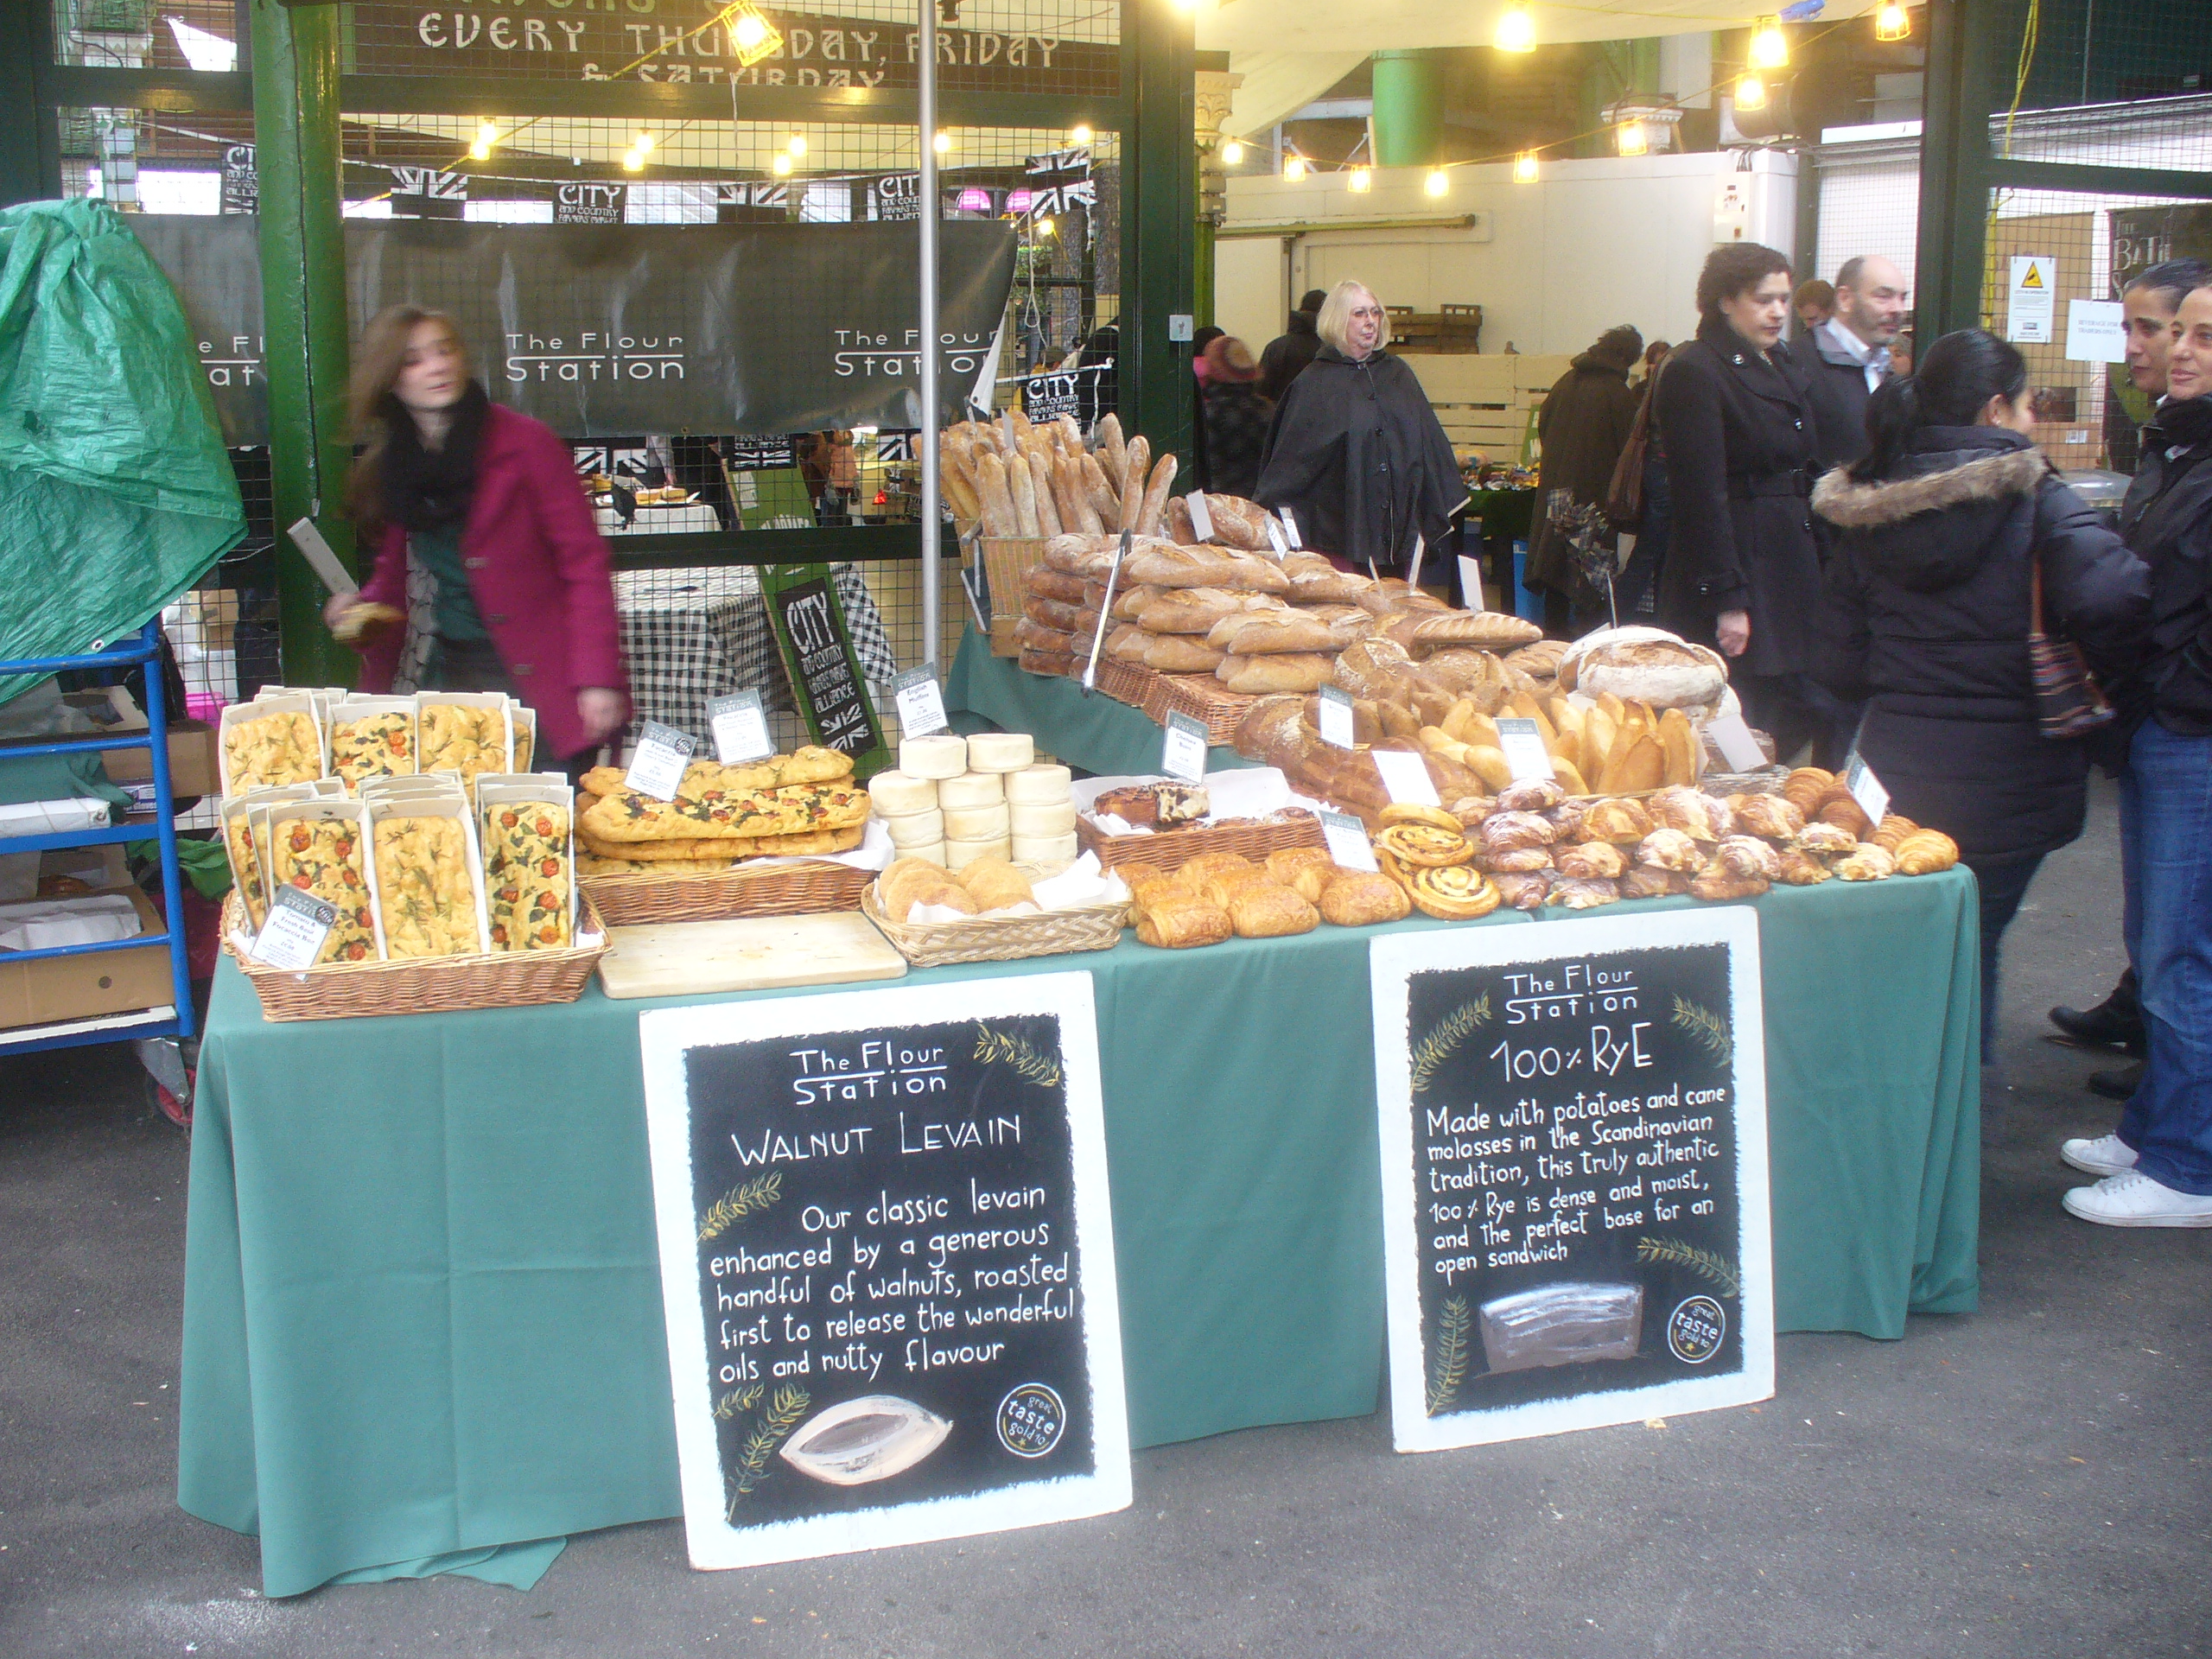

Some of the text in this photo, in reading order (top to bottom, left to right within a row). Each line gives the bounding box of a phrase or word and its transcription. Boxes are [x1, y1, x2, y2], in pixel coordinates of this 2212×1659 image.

[419, 12, 1060, 67] EVERY THUDAY, FRIDAY
[558, 184, 621, 208] CITY
[879, 175, 920, 198] CIT
[505, 333, 683, 350] The Flour
[835, 329, 998, 346] The Four
[505, 355, 684, 382] Station
[835, 352, 987, 377] Stato
[1027, 373, 1079, 401] CITY
[786, 591, 835, 655] CITY
[1503, 963, 1634, 995] The Flour
[1505, 991, 1638, 1025] Station
[789, 1041, 944, 1074] The Flour
[793, 1068, 947, 1105] Station
[1426, 1082, 1726, 1138] Made with potatoes and cane
[731, 1111, 1020, 1166] WALNUT LEVAIN
[1427, 1114, 1713, 1161] molasses in the Scandinavian
[1428, 1136, 1719, 1192] tradition, this truly authentic
[802, 1177, 1046, 1231] Our classic levain
[1485, 1191, 1516, 1224] Rye
[1526, 1196, 1541, 1212] is
[1548, 1186, 1597, 1209] dense
[1609, 1175, 1643, 1201] and
[1651, 1168, 1709, 1194] moist,
[1433, 1224, 1469, 1249] and
[1526, 1209, 1589, 1248] perfect
[1604, 1206, 1643, 1230] base
[1654, 1198, 1681, 1222] for
[1691, 1199, 1714, 1215] an
[710, 1223, 1050, 1276] enhanced by a generous
[1435, 1240, 1567, 1287] open sandwich
[717, 1251, 1068, 1312] handful of walnuts, roasted
[721, 1287, 1074, 1350] first to release the wonderful
[1676, 1313, 1718, 1339] taste
[720, 1337, 1005, 1382] oils and nutty flavour
[1007, 1400, 1055, 1434] taste
[1008, 1422, 1036, 1440] gold
